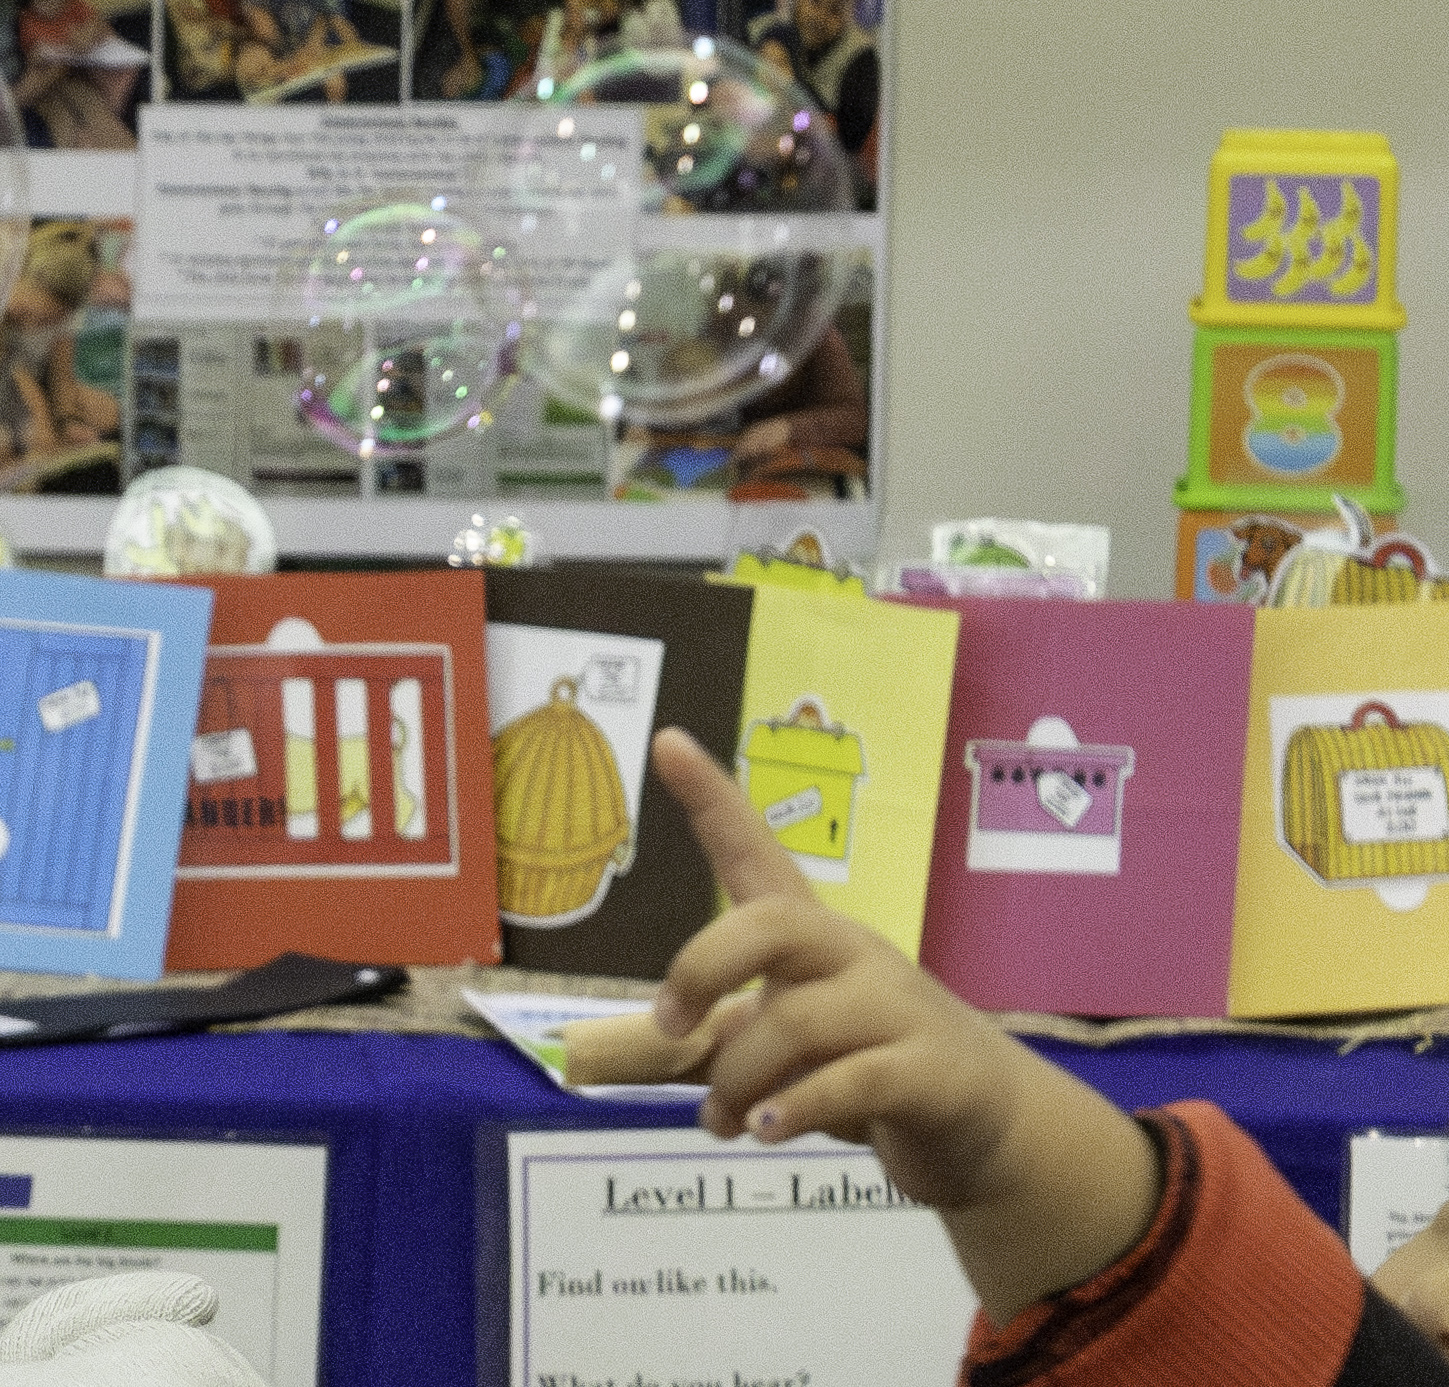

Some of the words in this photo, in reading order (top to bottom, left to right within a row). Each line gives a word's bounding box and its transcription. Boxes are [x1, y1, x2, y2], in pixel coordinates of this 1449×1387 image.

[1245, 352, 1345, 477] 8
[602, 1173, 706, 1209] Level
[723, 1173, 737, 1209] 1
[536, 1269, 604, 1299] Find
[656, 1267, 708, 1296] like
[716, 1266, 779, 1296] this.
